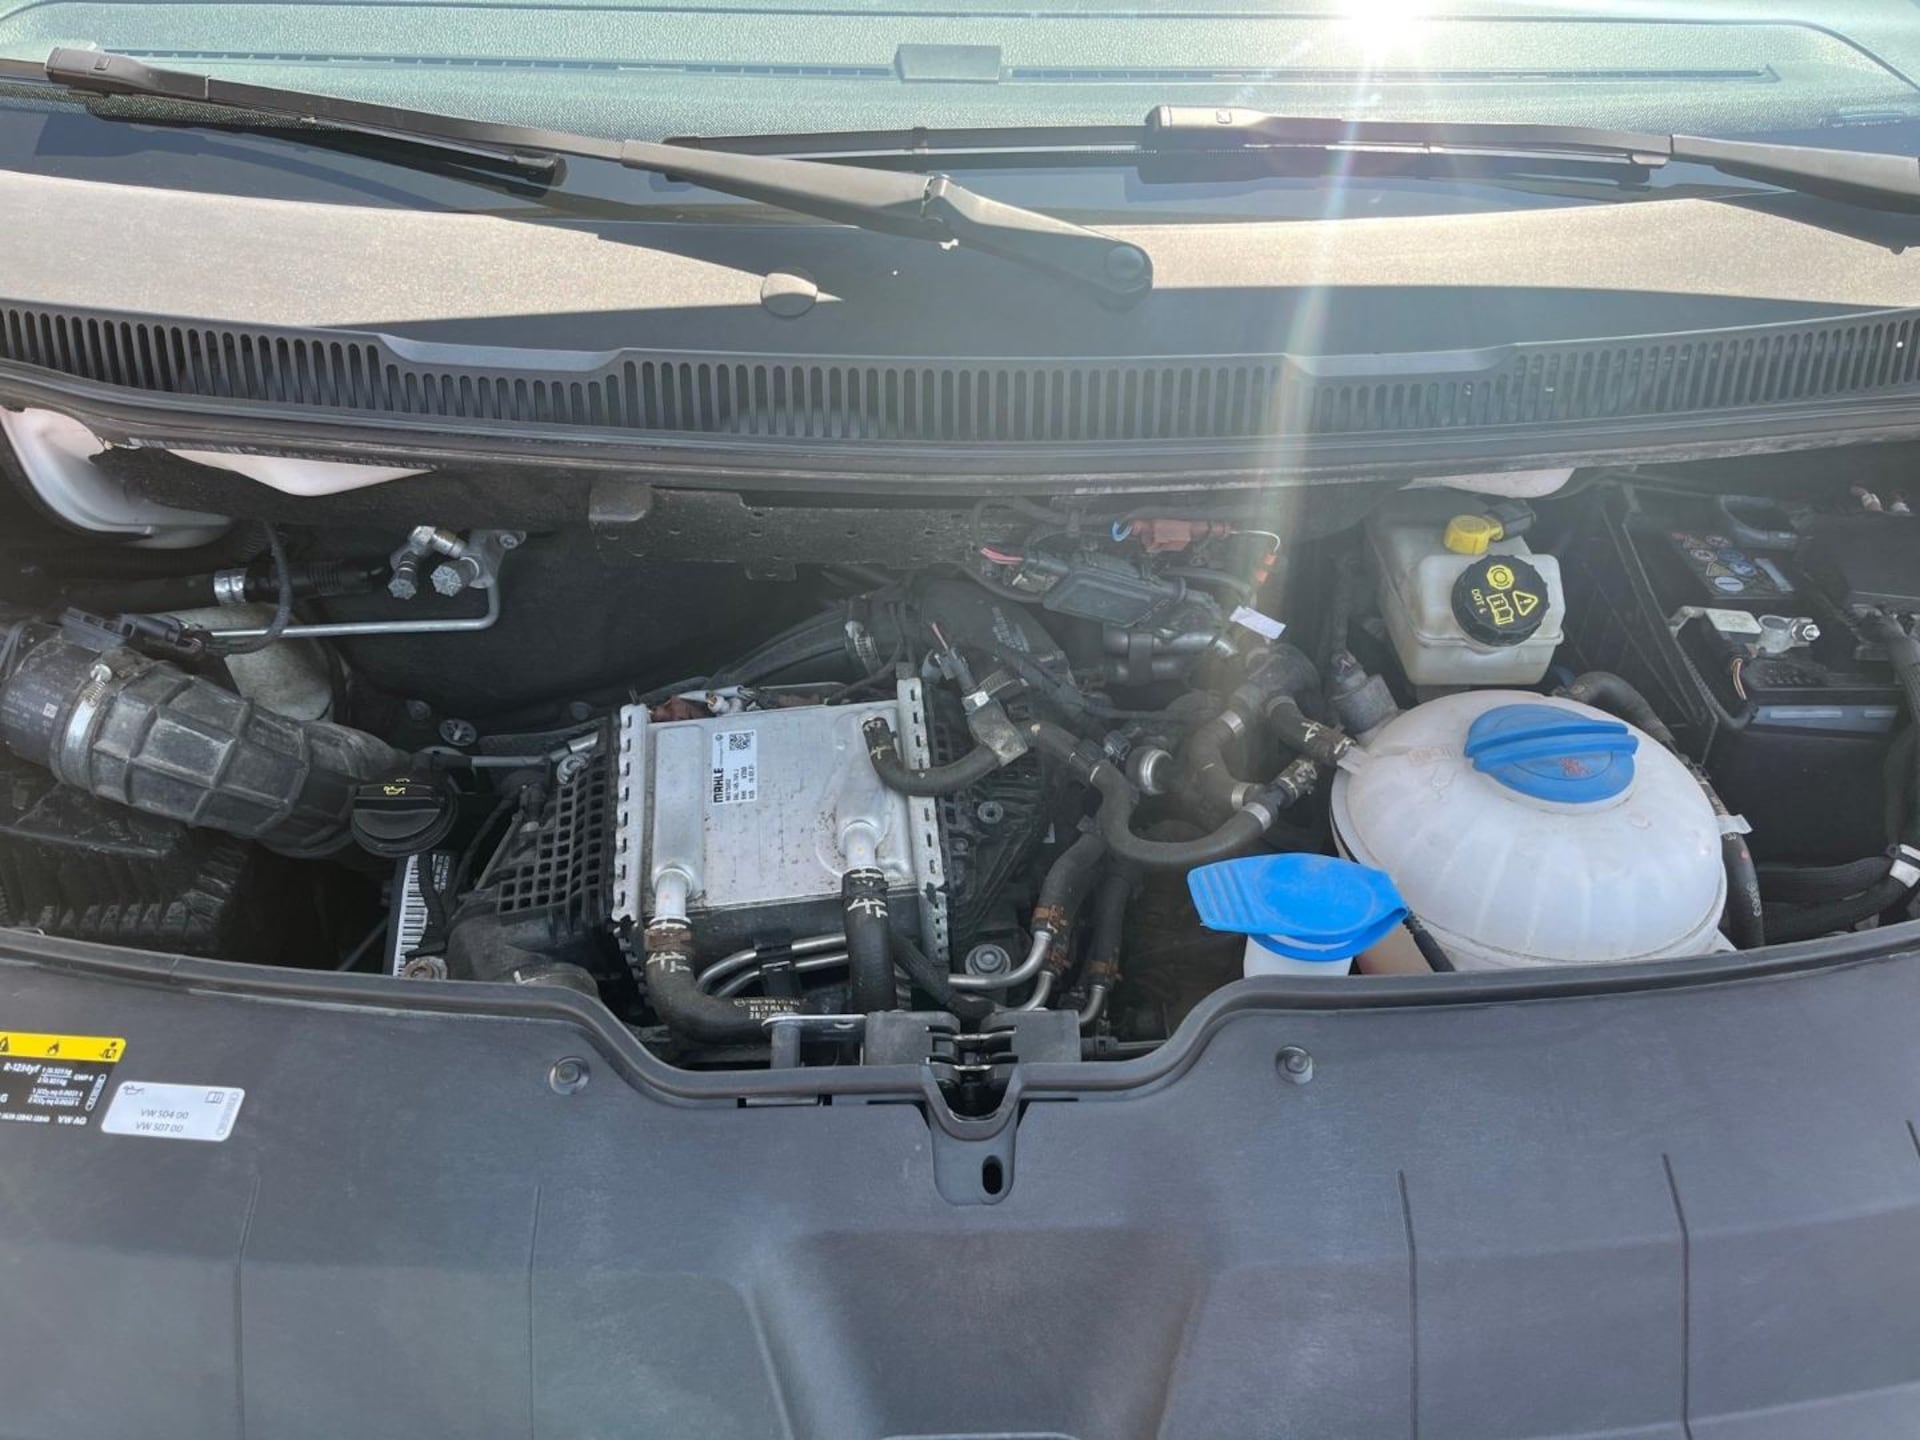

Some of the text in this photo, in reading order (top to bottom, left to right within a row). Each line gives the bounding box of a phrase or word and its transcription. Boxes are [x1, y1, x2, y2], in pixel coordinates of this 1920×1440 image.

[1471, 588, 1485, 605] DOT
[713, 767, 724, 803] MAHLE
[140, 1109, 189, 1120] VW 504 00
[57, 1115, 73, 1124] VW
[73, 1116, 88, 1126] AG
[135, 1121, 184, 1132] VW 507 00
